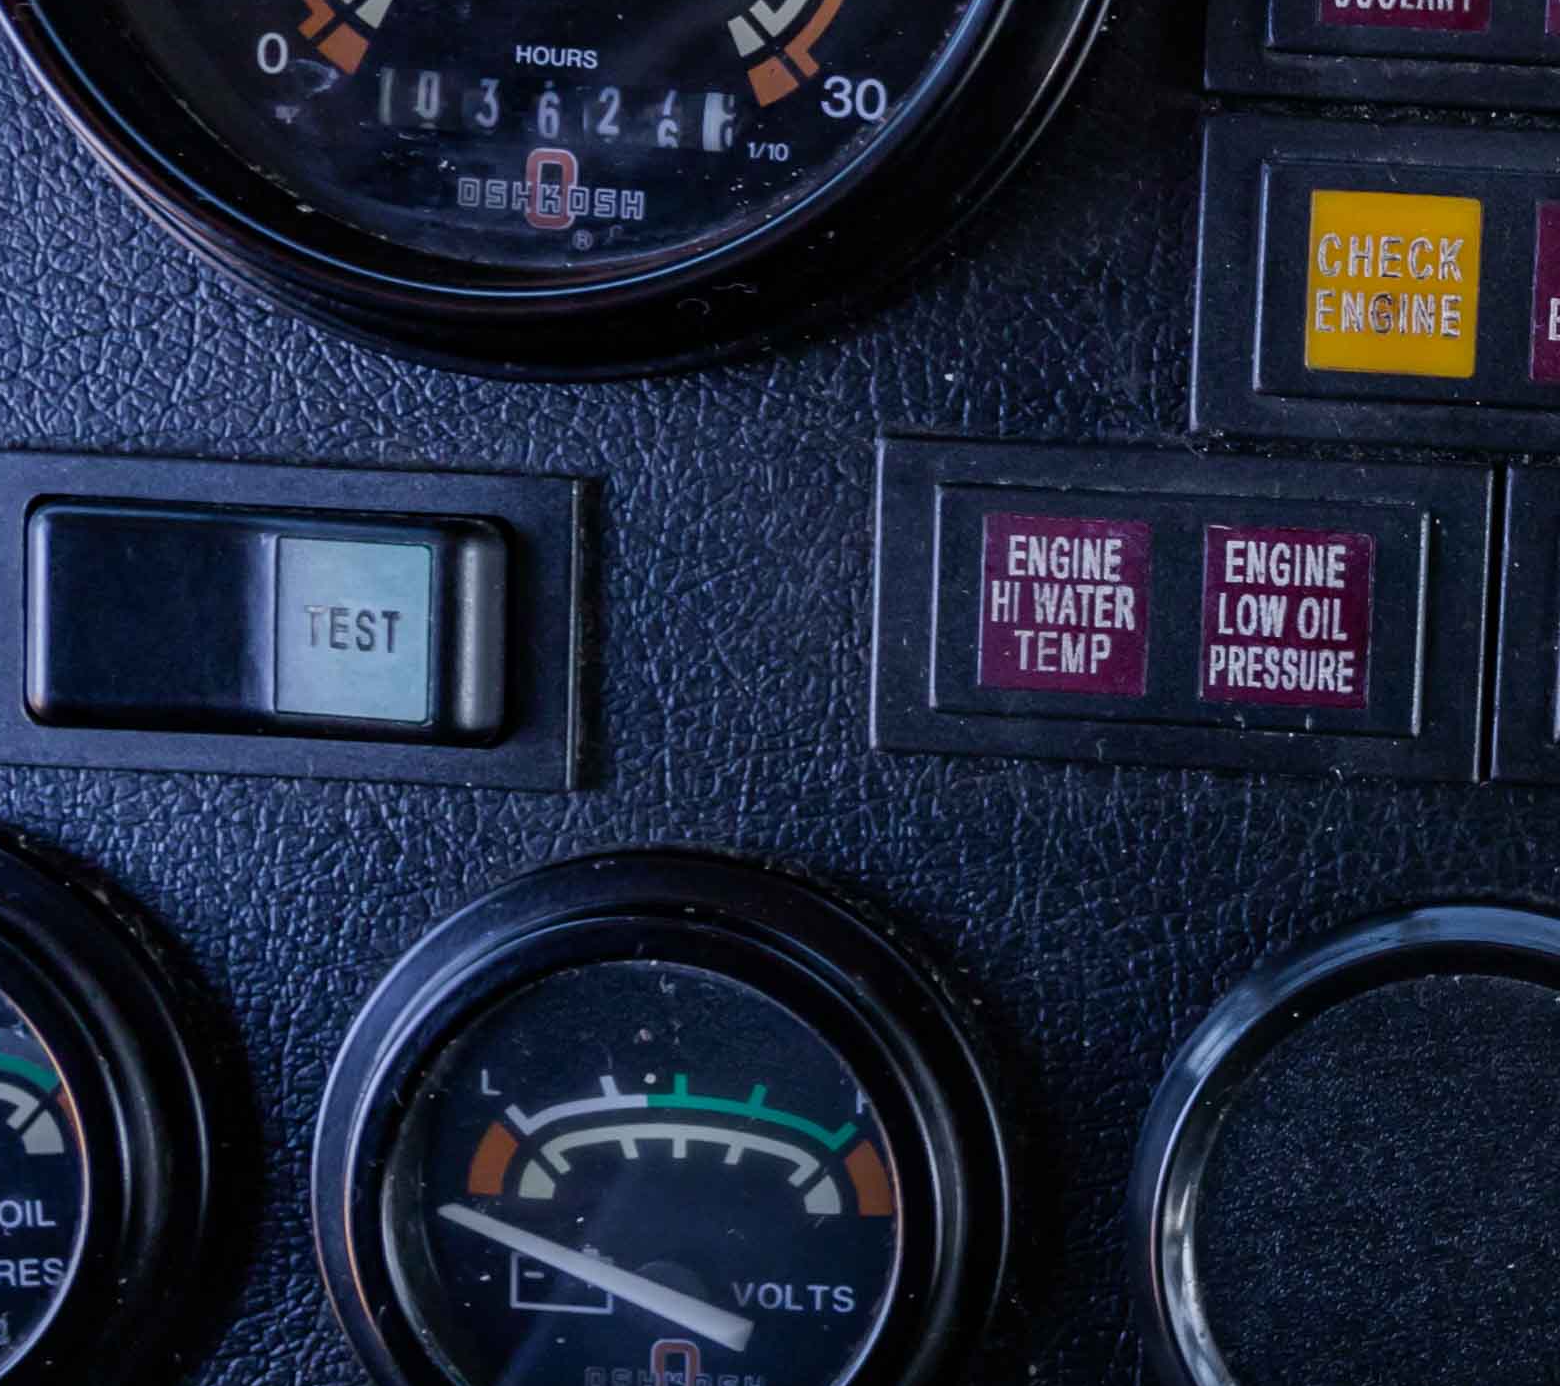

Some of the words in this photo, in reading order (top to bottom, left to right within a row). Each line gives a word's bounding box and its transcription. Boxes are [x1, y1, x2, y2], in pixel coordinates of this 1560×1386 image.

[256, 32, 289, 74] 0
[515, 44, 599, 70] HOURS
[820, 75, 889, 123] 30
[745, 140, 790, 163] 1/10
[1315, 232, 1465, 282] CHECK
[1313, 289, 1463, 339] ENGINE
[1007, 534, 1123, 583] ENGINE
[1224, 540, 1346, 590] ENGINE
[304, 603, 402, 655] TEST
[990, 580, 1021, 624] HI
[1032, 583, 1136, 631] WATER
[1217, 591, 1288, 639] LOW
[1296, 597, 1349, 642] OIL
[1013, 629, 1112, 676] TEMP
[1208, 644, 1355, 694] PRESSURE
[732, 1280, 857, 1314] VOLTS
